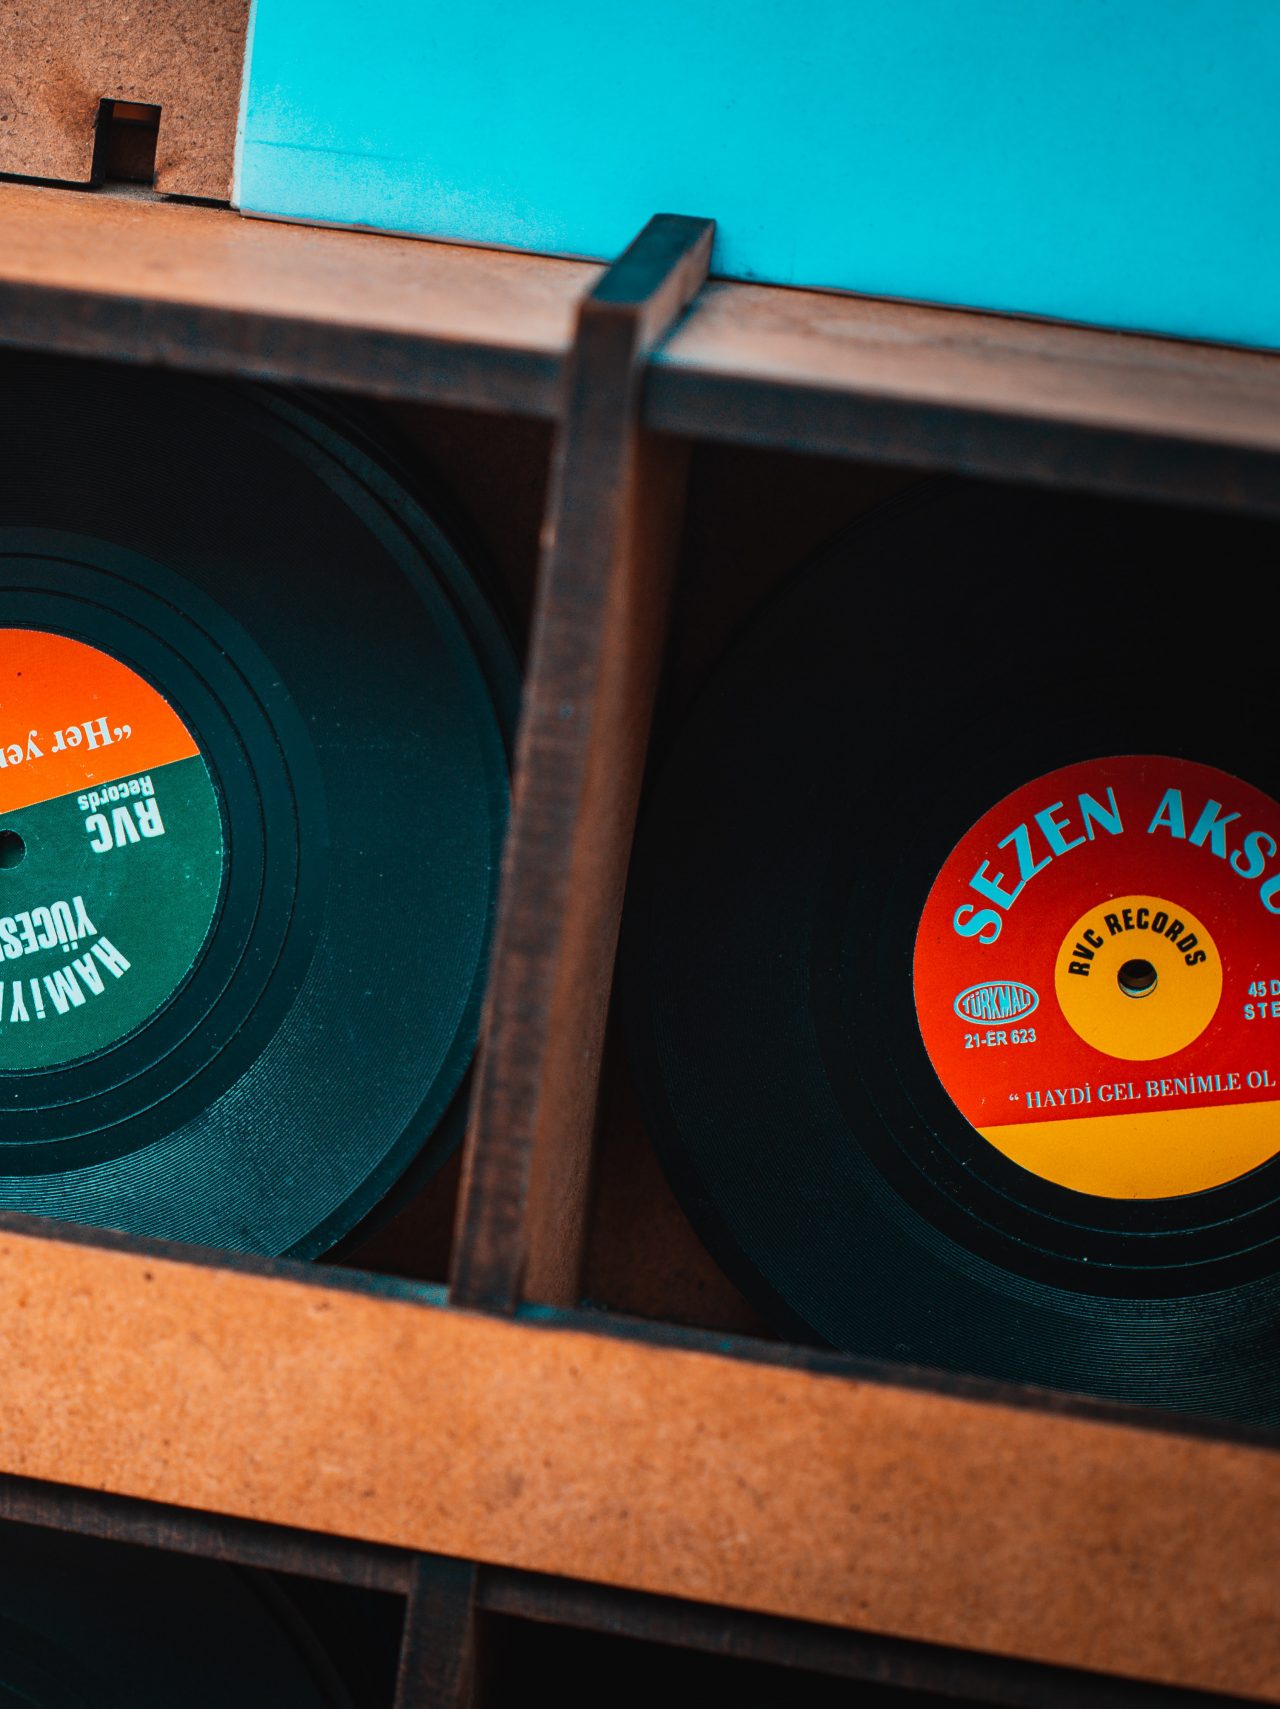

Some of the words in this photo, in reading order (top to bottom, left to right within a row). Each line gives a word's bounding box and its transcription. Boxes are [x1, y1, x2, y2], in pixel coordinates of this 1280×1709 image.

[77, 776, 155, 812] Records
[85, 797, 165, 853] RVC
[953, 787, 1123, 945] SEZEN
[1068, 929, 1105, 977] RVC
[1105, 908, 1207, 968] RECORDS
[1249, 981, 1267, 998] 45
[964, 1032, 1007, 1049] 21-ER
[1010, 1028, 1036, 1044] 623
[1025, 1082, 1092, 1109] HAYDİ
[1098, 1082, 1141, 1103] GEL
[1147, 1072, 1241, 1098] BENİMLE
[1247, 1070, 1276, 1089] OL
